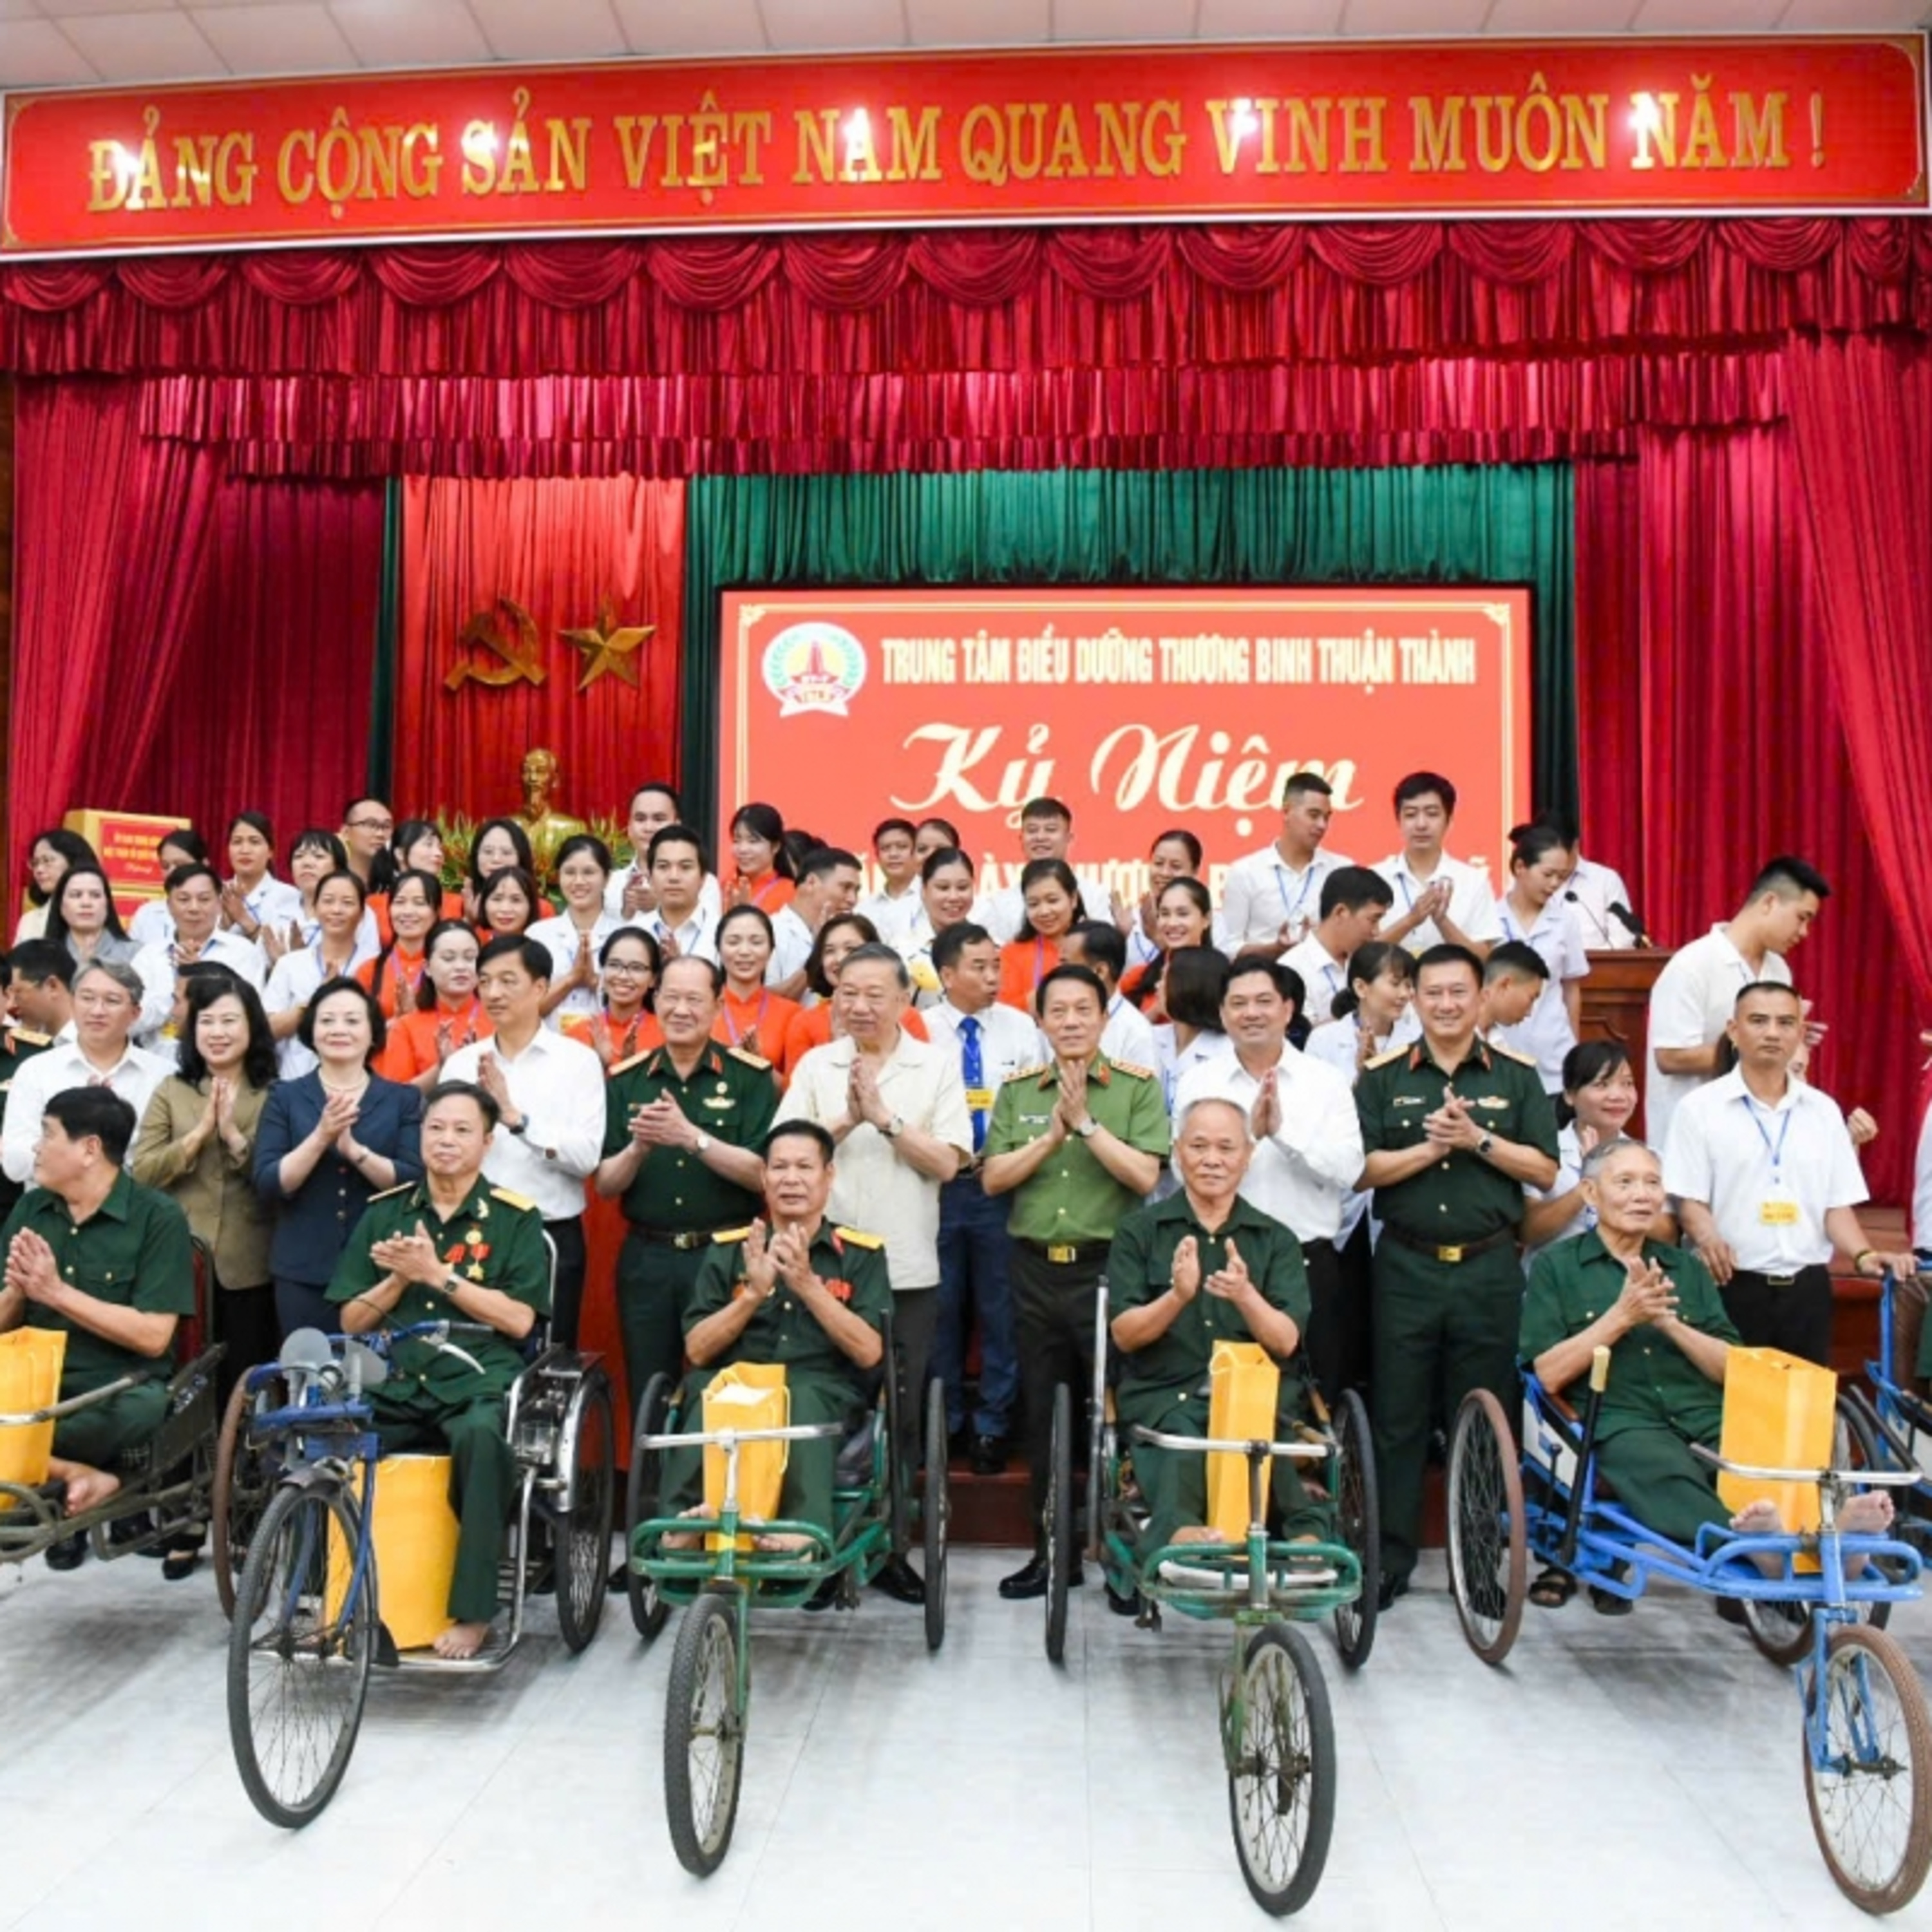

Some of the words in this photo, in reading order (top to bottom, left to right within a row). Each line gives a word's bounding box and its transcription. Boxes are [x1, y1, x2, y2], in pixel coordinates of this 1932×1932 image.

[88, 106, 257, 213] ĐẢNG
[277, 106, 443, 219] CỘNG
[460, 86, 591, 196] SẢN
[614, 90, 772, 205] VIỆT
[793, 107, 942, 184] NAM
[960, 99, 1187, 186] QUANG
[1206, 97, 1387, 175] VINH
[1409, 71, 1609, 173] MUÔN
[1628, 72, 1789, 169] NĂM
[1809, 92, 1824, 167] !
[880, 638, 956, 685] TRUNG
[962, 629, 1011, 685] TÂM
[1075, 627, 1153, 685] DƯỠNG
[1159, 632, 1250, 685] THƯƠNG
[1255, 638, 1312, 685] BINH
[1318, 627, 1394, 695] THUẬN
[1399, 629, 1477, 685] THÀNH
[1090, 723, 1365, 837] Niệm
